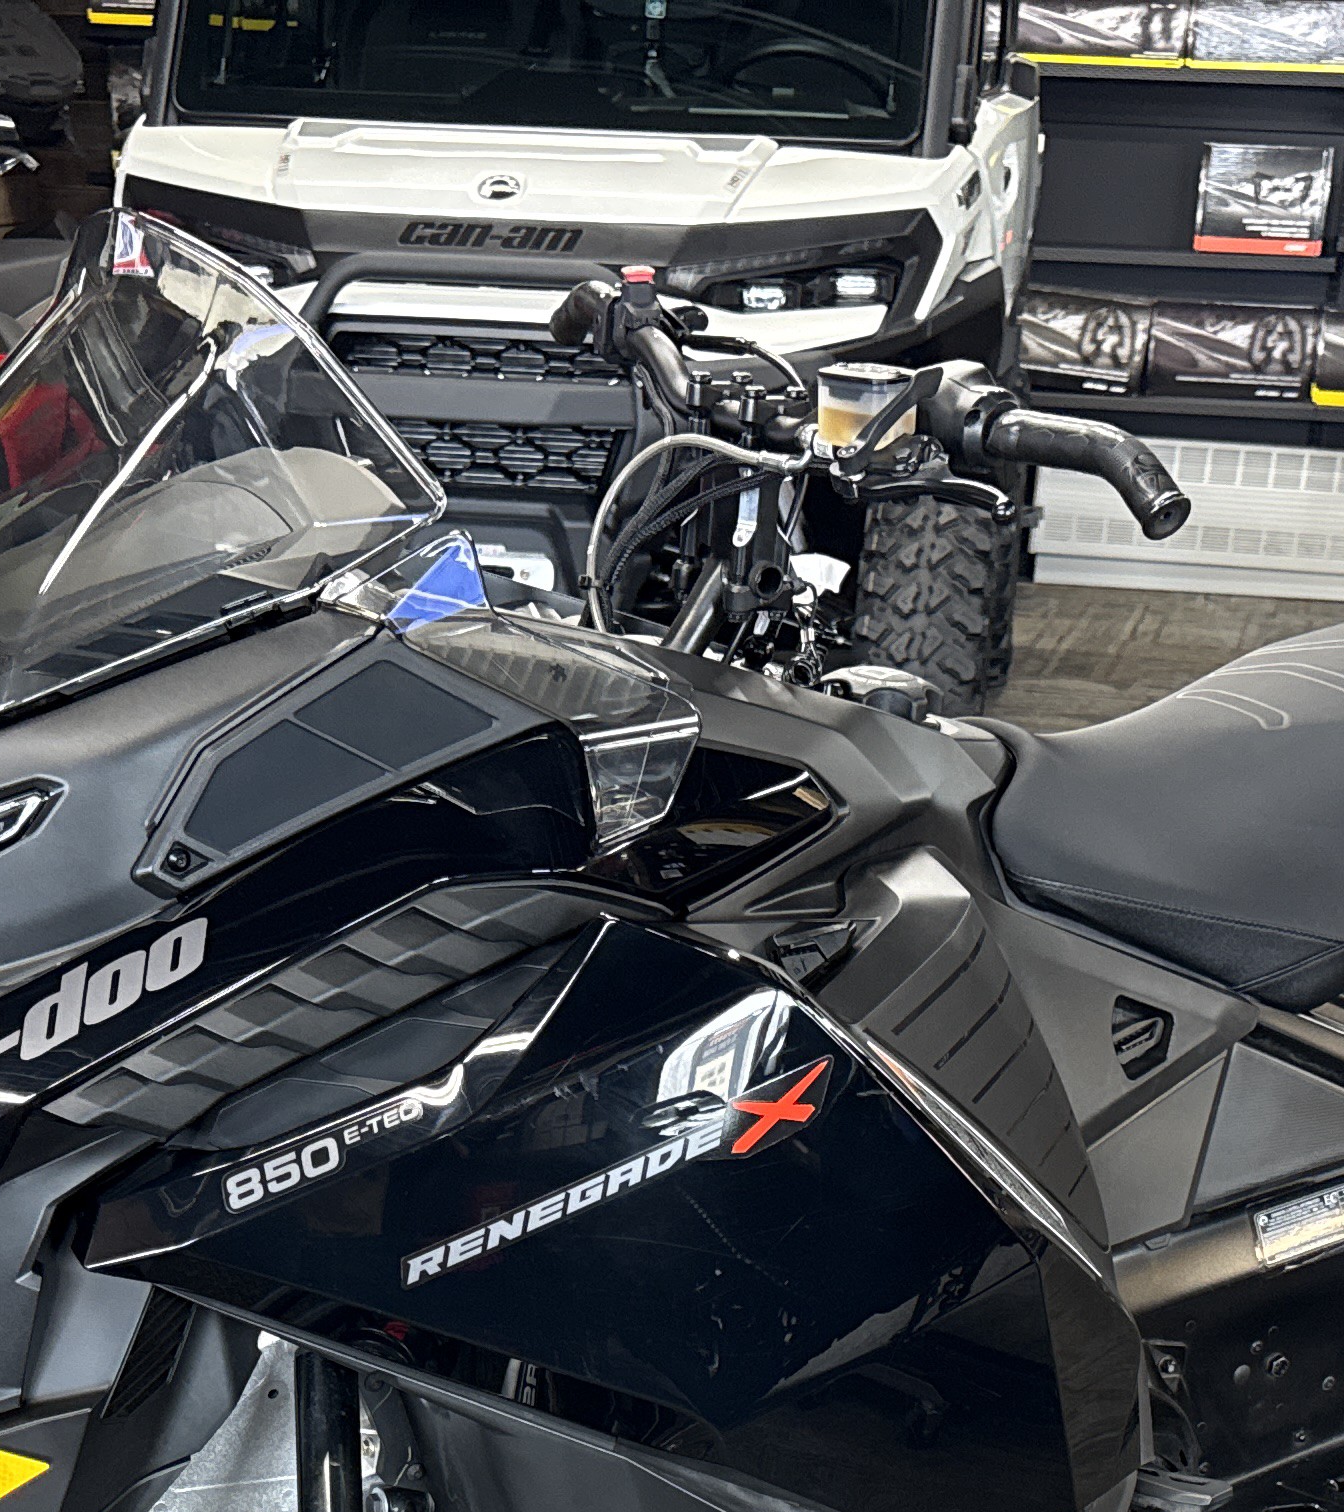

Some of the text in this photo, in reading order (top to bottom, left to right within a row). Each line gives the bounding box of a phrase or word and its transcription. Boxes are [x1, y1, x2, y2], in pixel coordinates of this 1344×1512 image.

[398, 221, 584, 253] can-am
[225, 1136, 340, 1210] 850
[406, 1119, 725, 1285] RENEGADE
